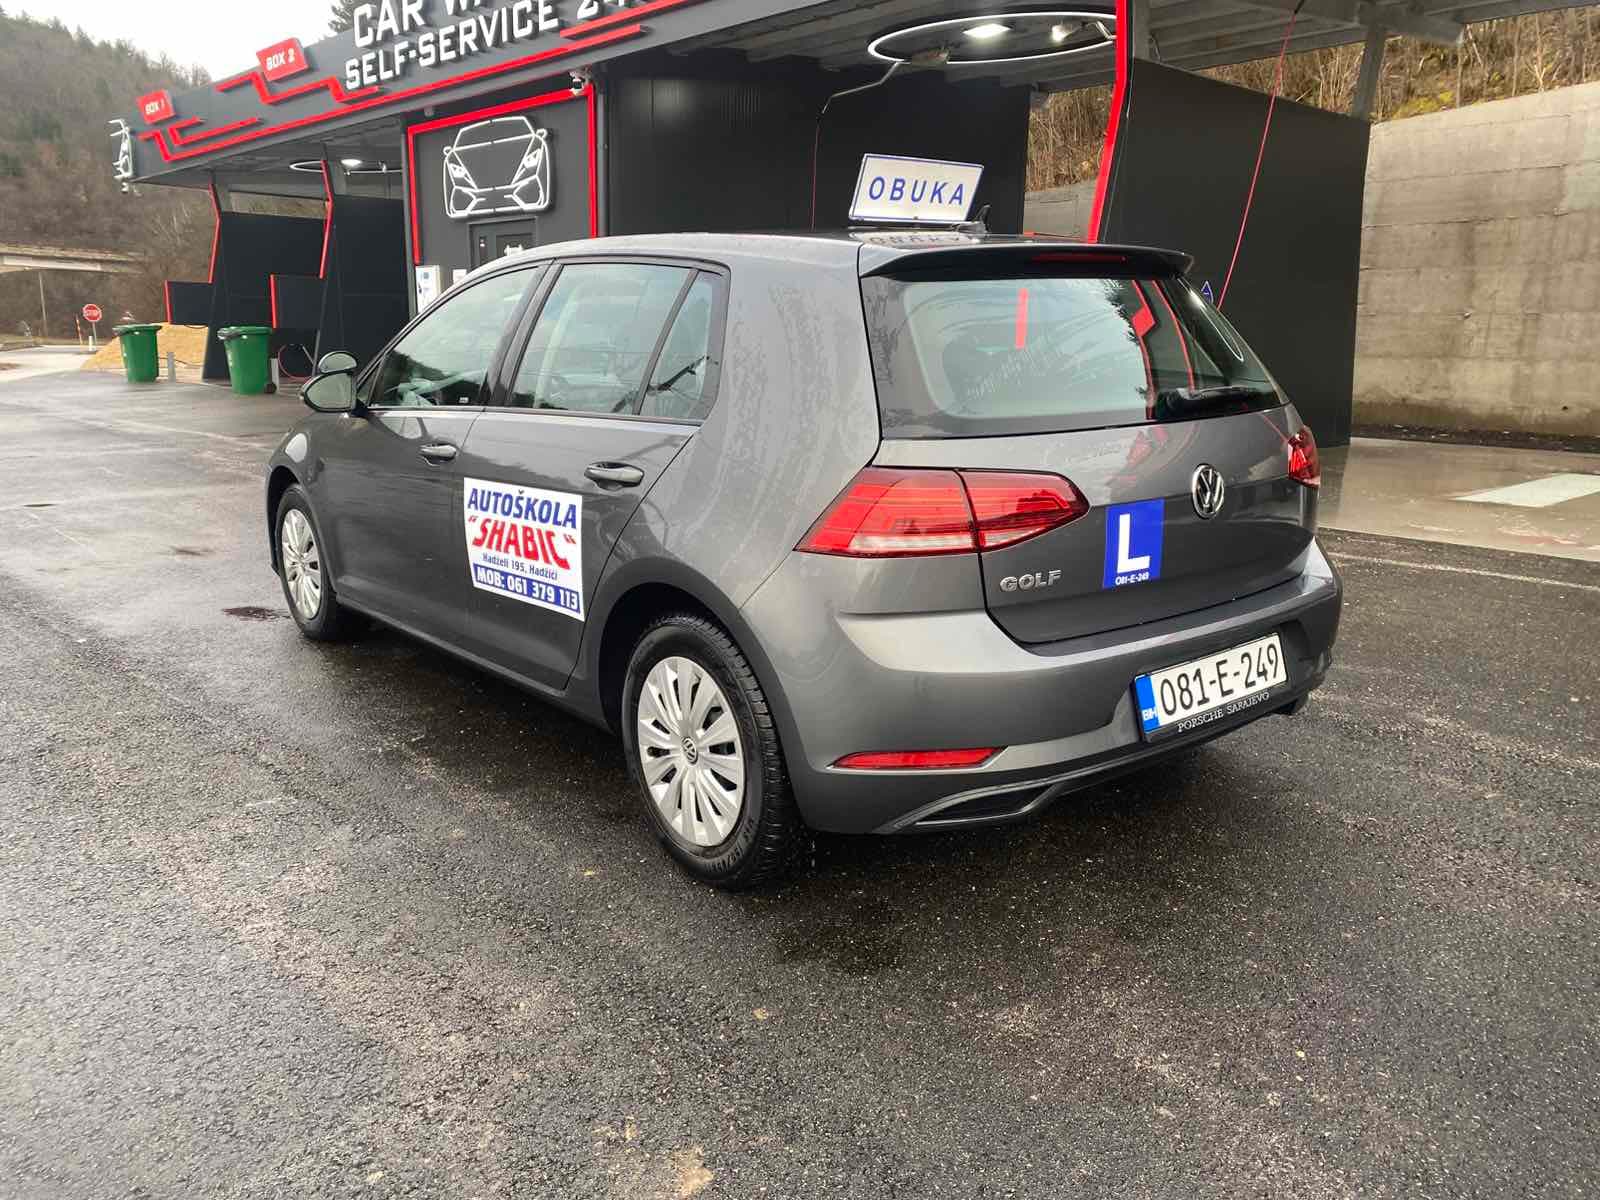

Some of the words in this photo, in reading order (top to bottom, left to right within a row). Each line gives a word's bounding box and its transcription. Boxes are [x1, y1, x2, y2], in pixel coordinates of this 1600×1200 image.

[345, 0, 560, 89] SELF-SERVICE
[353, 0, 425, 48] CAR
[868, 176, 964, 206] OBUKA
[467, 487, 577, 529] AUTOŠKOLA
[1117, 514, 1150, 573] L
[476, 566, 505, 588] MOB:
[507, 574, 528, 595] 061
[531, 582, 555, 604] 379
[1000, 569, 1061, 592] GOLF
[1160, 643, 1279, 716] 081-E-249
[1177, 709, 1224, 733] PORSCHE
[1226, 691, 1270, 715] SARAJEVO
